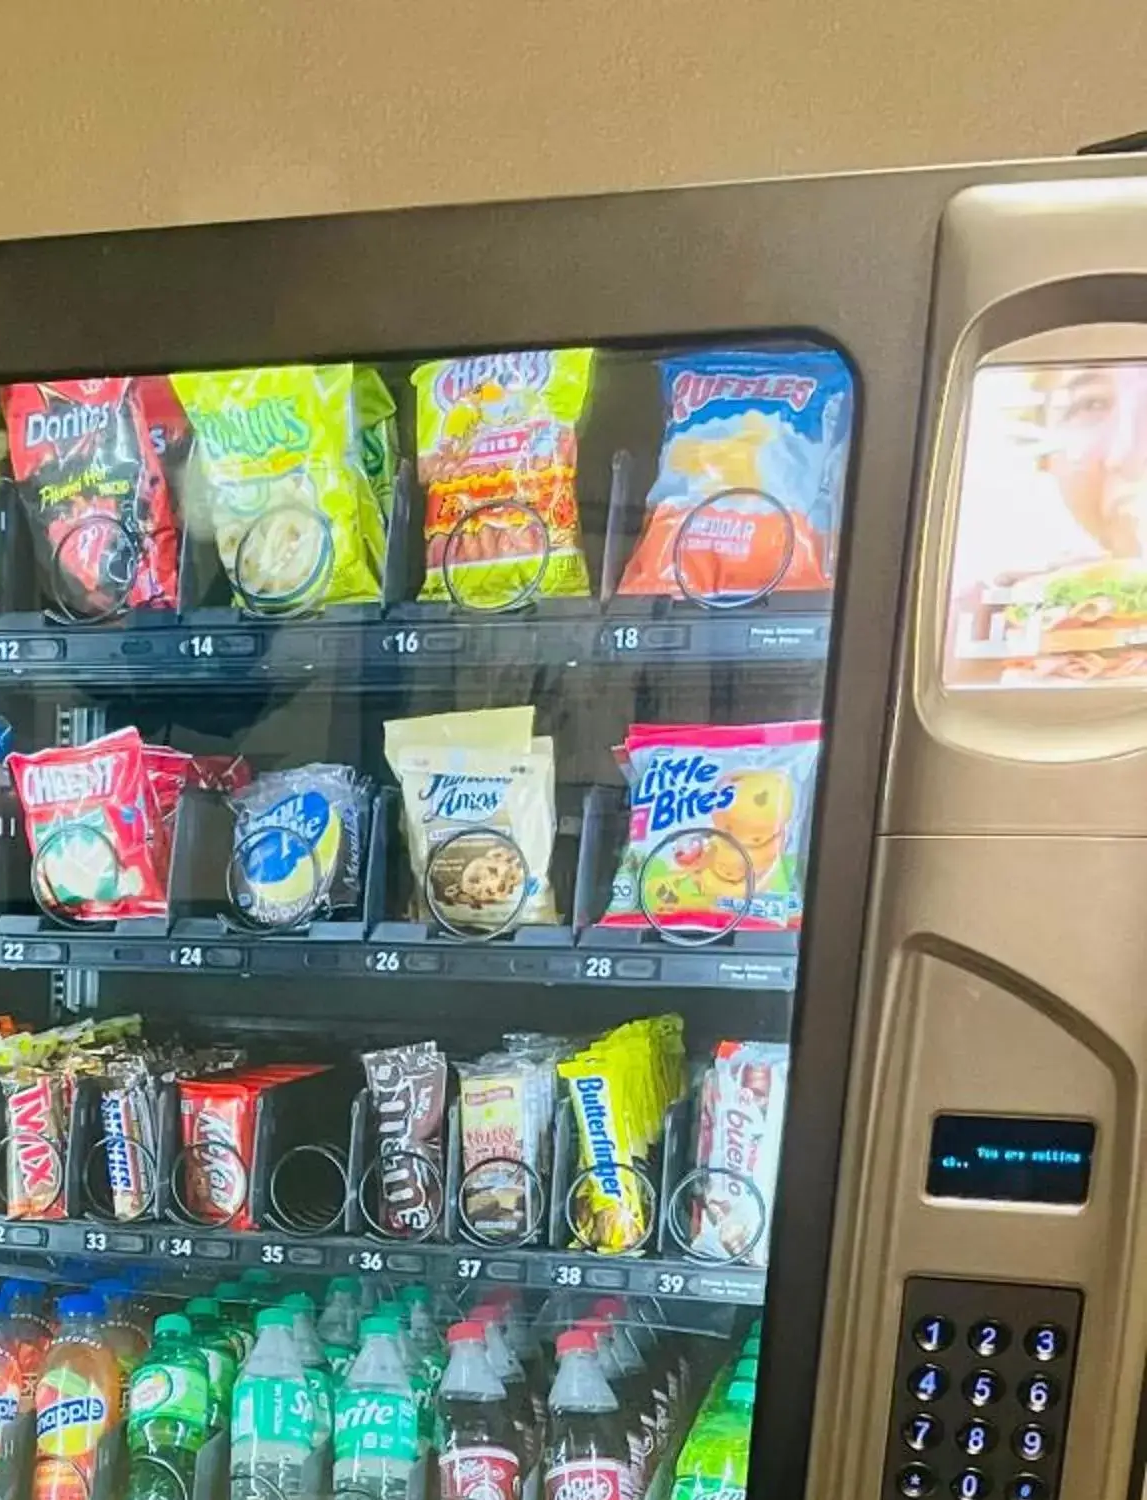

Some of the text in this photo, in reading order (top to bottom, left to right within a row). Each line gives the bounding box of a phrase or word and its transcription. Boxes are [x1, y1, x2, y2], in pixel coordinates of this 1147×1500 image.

[673, 370, 818, 422] RUFFLES
[25, 400, 110, 448] Doritos
[189, 636, 213, 656] 14
[394, 631, 419, 652] 16
[613, 627, 638, 649] 18
[633, 756, 720, 804] Little
[651, 784, 735, 832] Bites
[4, 944, 25, 961] 22
[180, 948, 203, 965] 24
[376, 953, 399, 970] 26
[586, 958, 613, 978] 28
[8, 1083, 55, 1191] TWIX
[576, 1076, 622, 1198] Butterfinger
[726, 1109, 754, 1197] bueno
[86, 1233, 107, 1250] 33
[170, 1238, 192, 1256] 34
[261, 1245, 284, 1263] 35
[359, 1252, 383, 1271] 36
[458, 1260, 482, 1278] 37
[556, 1266, 582, 1286] 38
[658, 1273, 684, 1293] 39
[926, 1322, 1054, 1354] 1 2 3
[919, 1371, 1048, 1406] 4 5 6
[915, 1421, 1042, 1456] 7 8 9
[962, 1474, 978, 1497] 0
